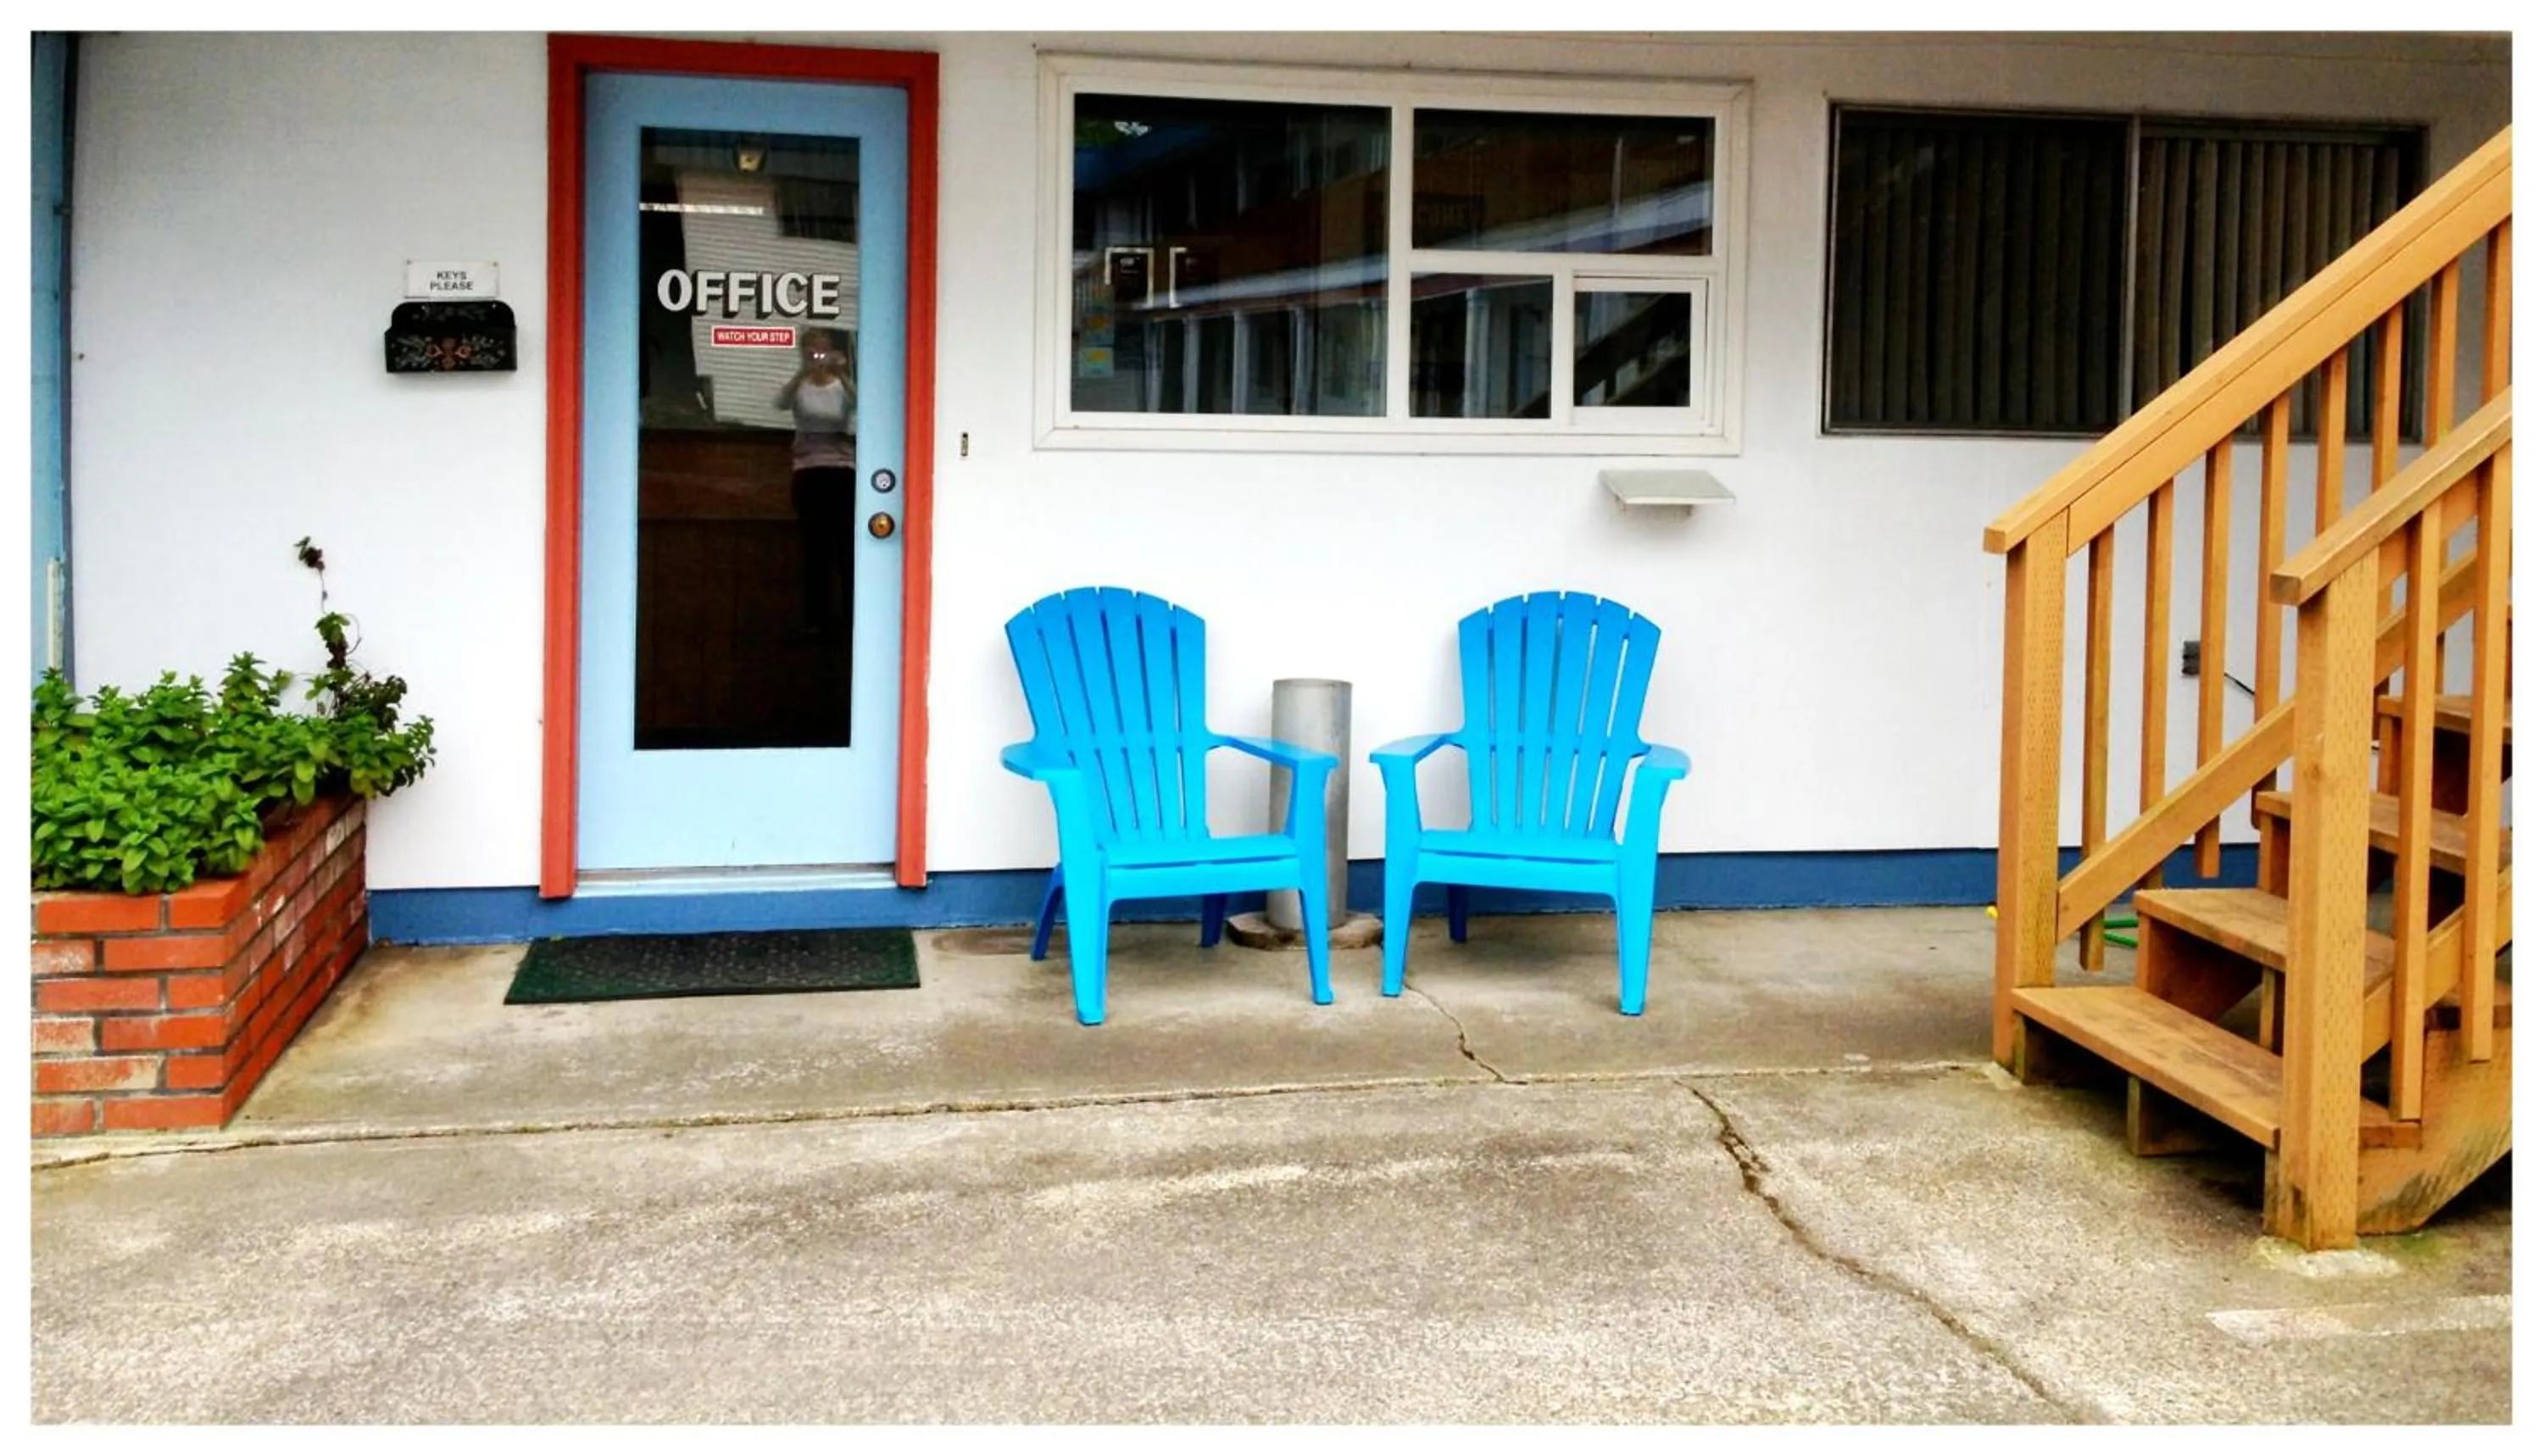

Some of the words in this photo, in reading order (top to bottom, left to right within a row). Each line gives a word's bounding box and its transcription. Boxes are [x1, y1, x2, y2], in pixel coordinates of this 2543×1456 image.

[437, 270, 467, 281] KEYS
[430, 281, 473, 291] PLEASE
[657, 269, 842, 317] OFFICE
[717, 331, 745, 342] WATCH
[747, 331, 769, 342] YOUR
[769, 332, 791, 343] STEP
